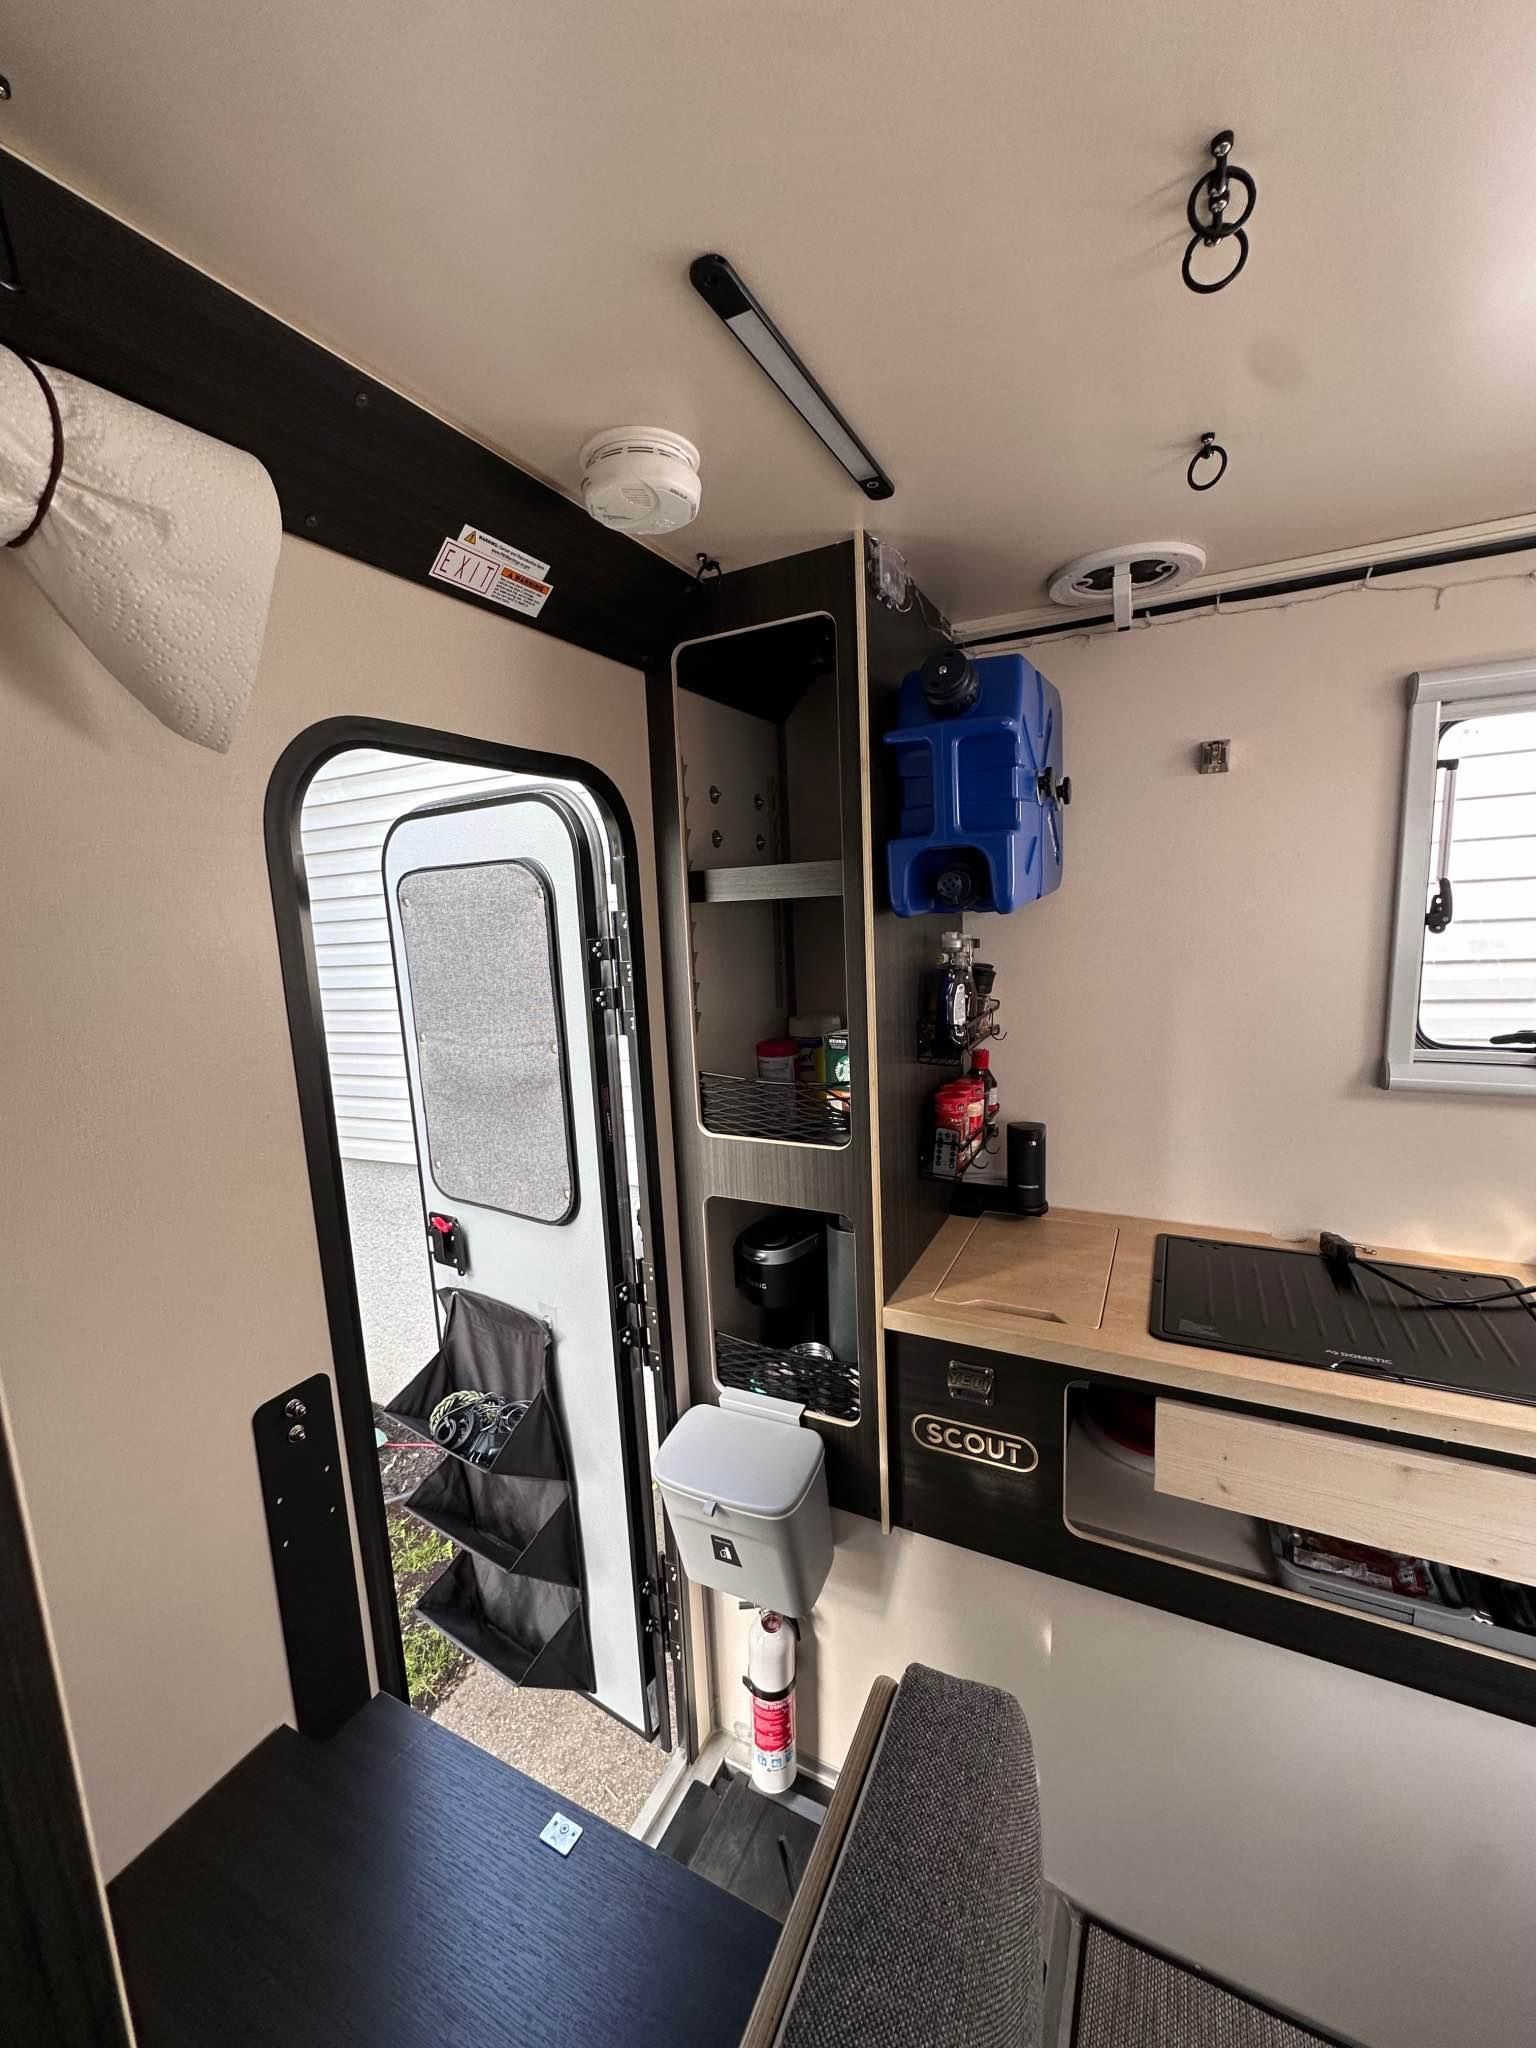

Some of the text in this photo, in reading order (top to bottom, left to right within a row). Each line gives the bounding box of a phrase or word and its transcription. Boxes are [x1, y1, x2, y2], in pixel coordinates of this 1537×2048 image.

[440, 549, 494, 587] EXIT
[514, 574, 544, 592] WARNING
[1340, 1352, 1393, 1364] DOMETIC
[926, 1423, 1022, 1464] SCOUT
